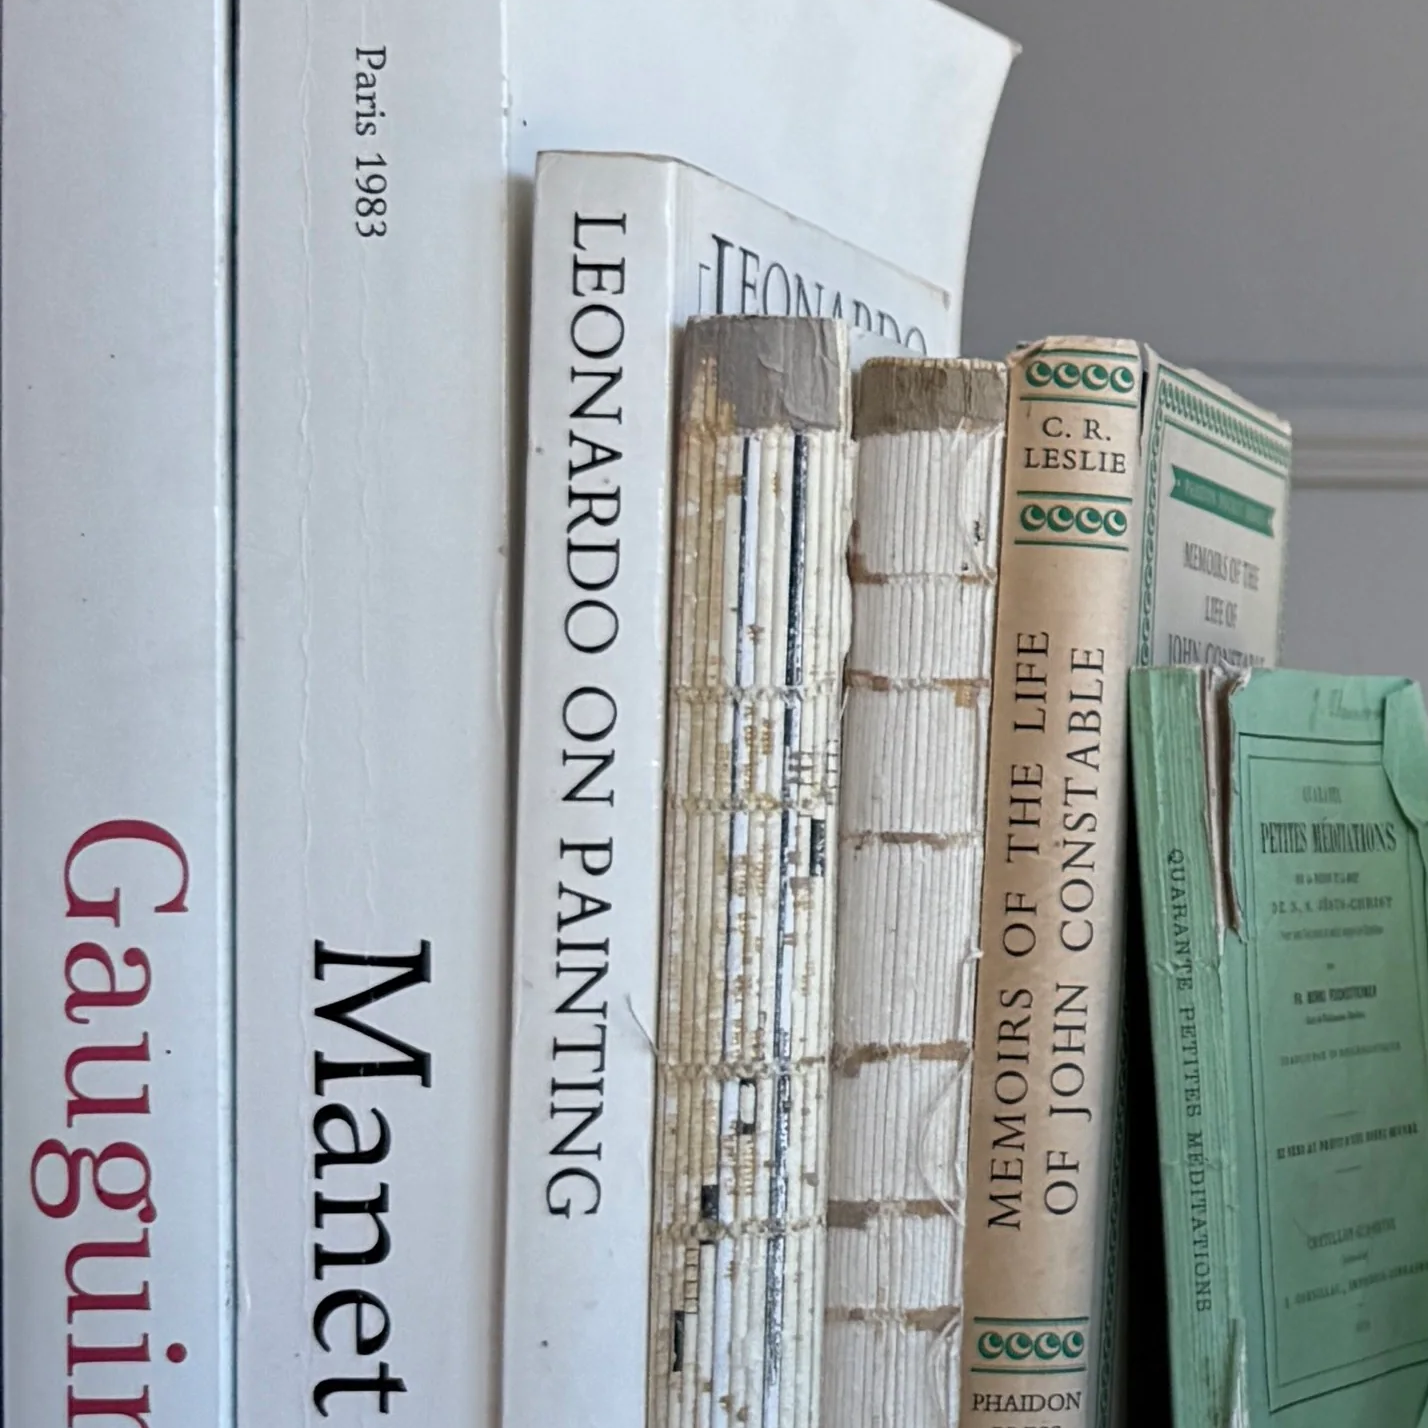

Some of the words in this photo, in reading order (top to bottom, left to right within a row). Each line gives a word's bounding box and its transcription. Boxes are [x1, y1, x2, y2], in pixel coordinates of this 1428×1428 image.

[356, 46, 386, 136] Paris
[356, 154, 387, 237] 1983
[564, 212, 626, 653] LEONARDO
[1025, 448, 1125, 474] LESLIE
[1042, 416, 1071, 438] C.
[1083, 419, 1110, 441] R.
[1014, 632, 1049, 732] LIFE
[562, 687, 617, 806] ON
[1055, 648, 1104, 951] CONSTABLE
[1007, 764, 1043, 862] THE
[1260, 822, 1307, 854] PETITES
[1003, 892, 1036, 957] OF
[1165, 848, 1194, 991] QUARANTE
[546, 837, 612, 1218] PAINTING
[1049, 983, 1092, 1121] JOHN
[1179, 1003, 1201, 1117] PETITES
[988, 989, 1030, 1230] MEMOIRS
[313, 940, 431, 1417] Manet
[1044, 1151, 1079, 1215] OF
[1186, 1129, 1213, 1313] MÉDITATIONS
[972, 1392, 1081, 1412] PHAIDON
